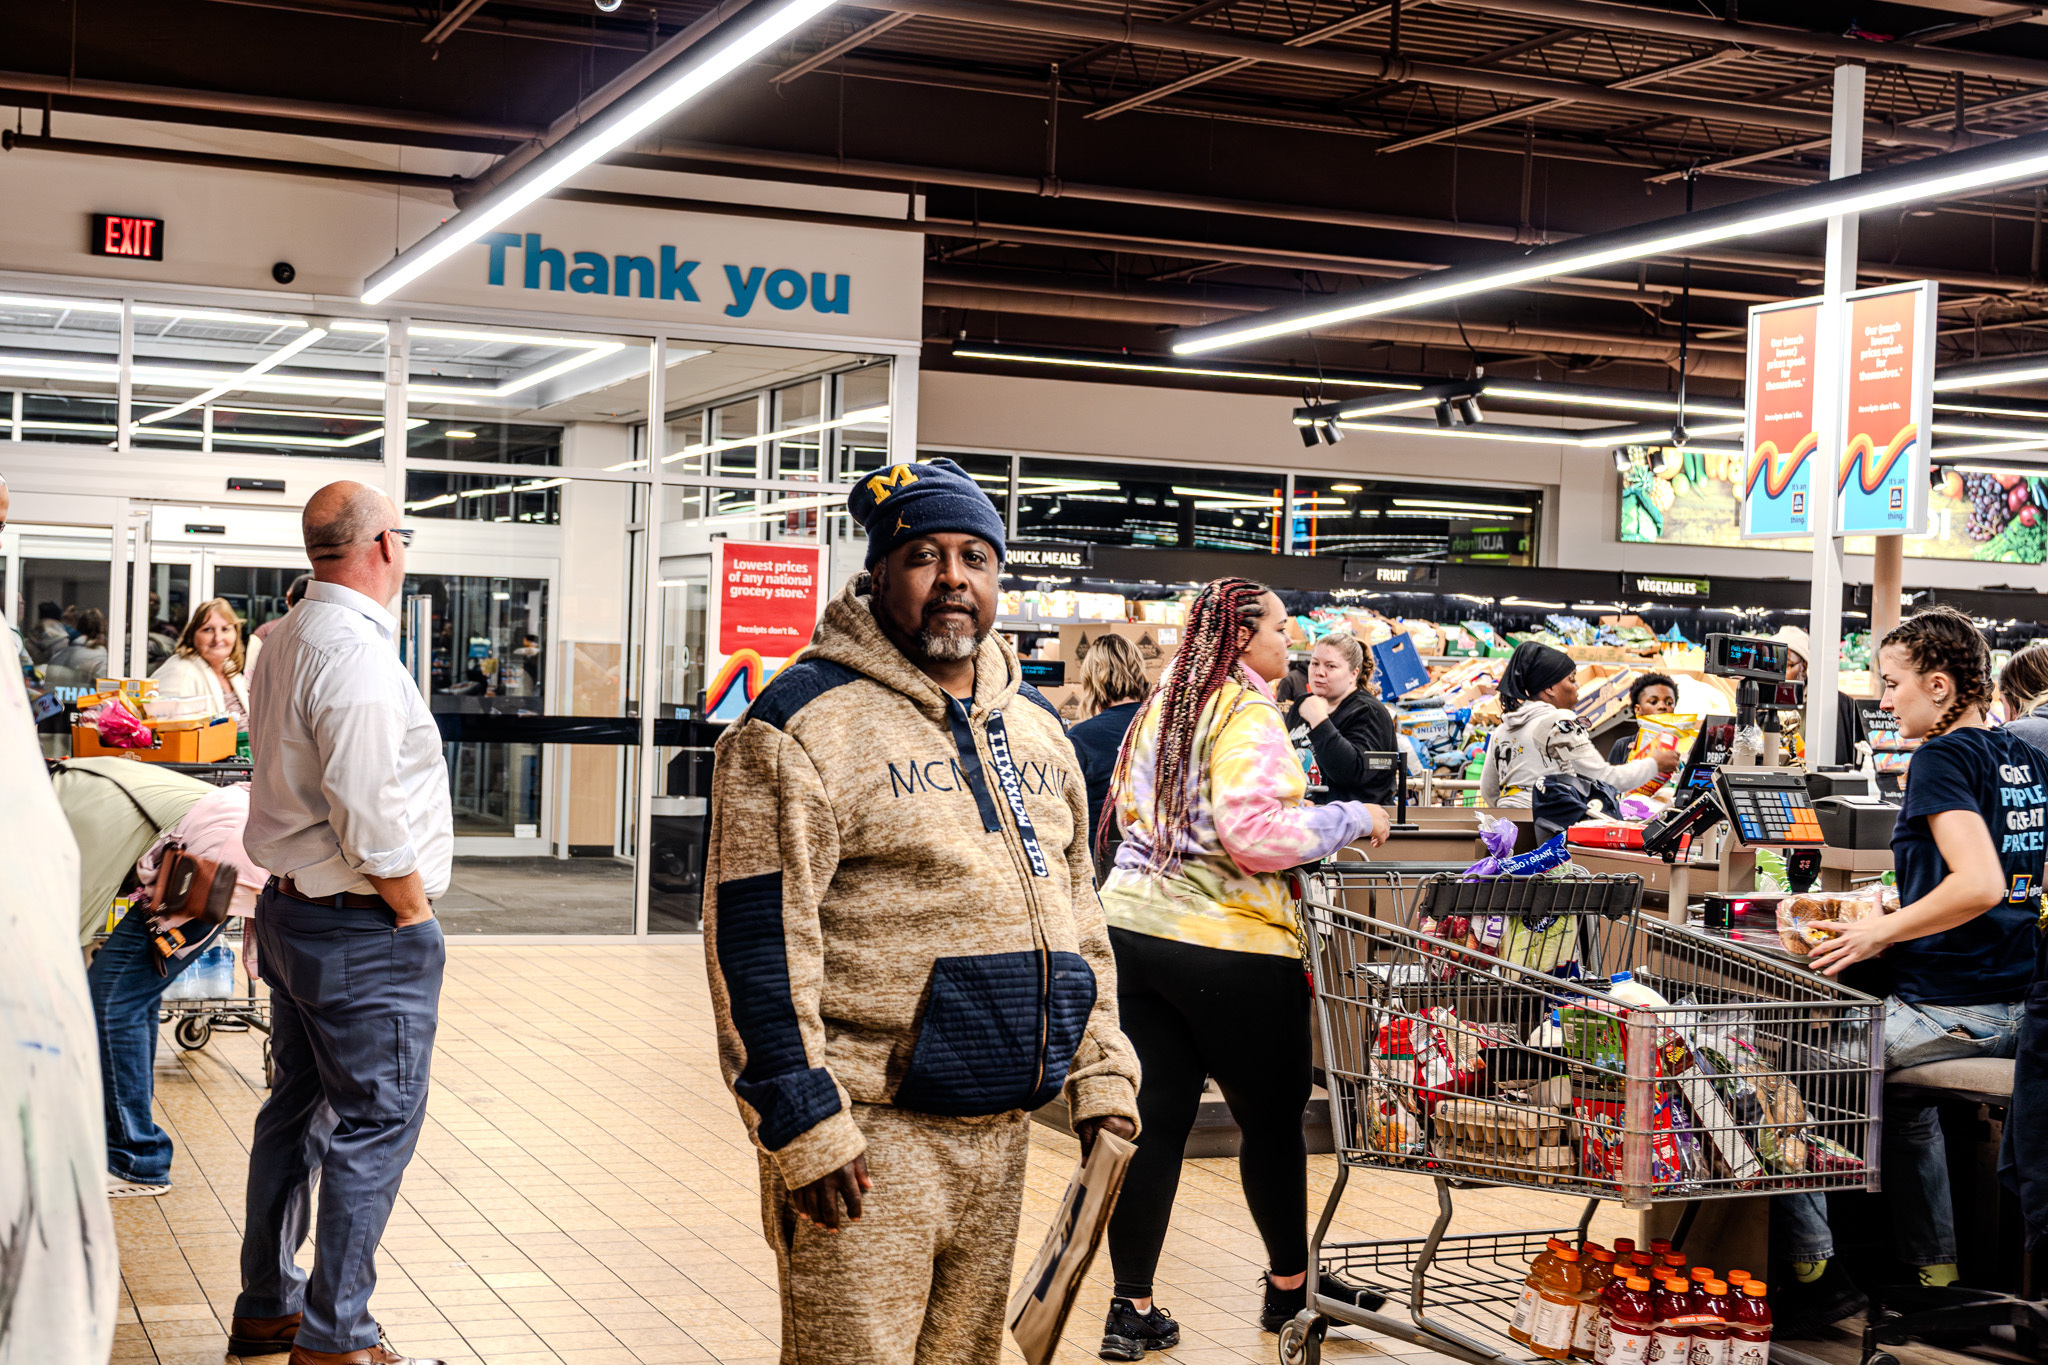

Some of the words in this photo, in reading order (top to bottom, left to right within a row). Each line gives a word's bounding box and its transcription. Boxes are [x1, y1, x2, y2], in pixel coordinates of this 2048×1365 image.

[105, 216, 155, 256] EXIT
[477, 232, 702, 303] Thank
[722, 264, 850, 317] you
[1861, 347, 1881, 361] prices
[1881, 344, 1904, 358] speak
[1767, 359, 1786, 372] prices
[1787, 356, 1806, 369] speak
[1876, 358, 1887, 368] for
[1781, 369, 1791, 378] for
[866, 464, 919, 505] M
[1887, 512, 1904, 521] thing.
[1005, 550, 1040, 564] QUICK
[1041, 551, 1081, 566] MEALS
[733, 559, 773, 572] Lowest
[774, 561, 809, 574] prices
[728, 571, 741, 583] of
[742, 575, 763, 587] any
[765, 573, 812, 586] national
[1376, 568, 1408, 582] FRUIT
[729, 585, 773, 600] grocery
[1636, 579, 1697, 595] VEGETABLES
[737, 625, 767, 636] Receipts
[768, 625, 788, 636] don't
[788, 627, 800, 636] lie.
[1417, 725, 1446, 735] SALTINE
